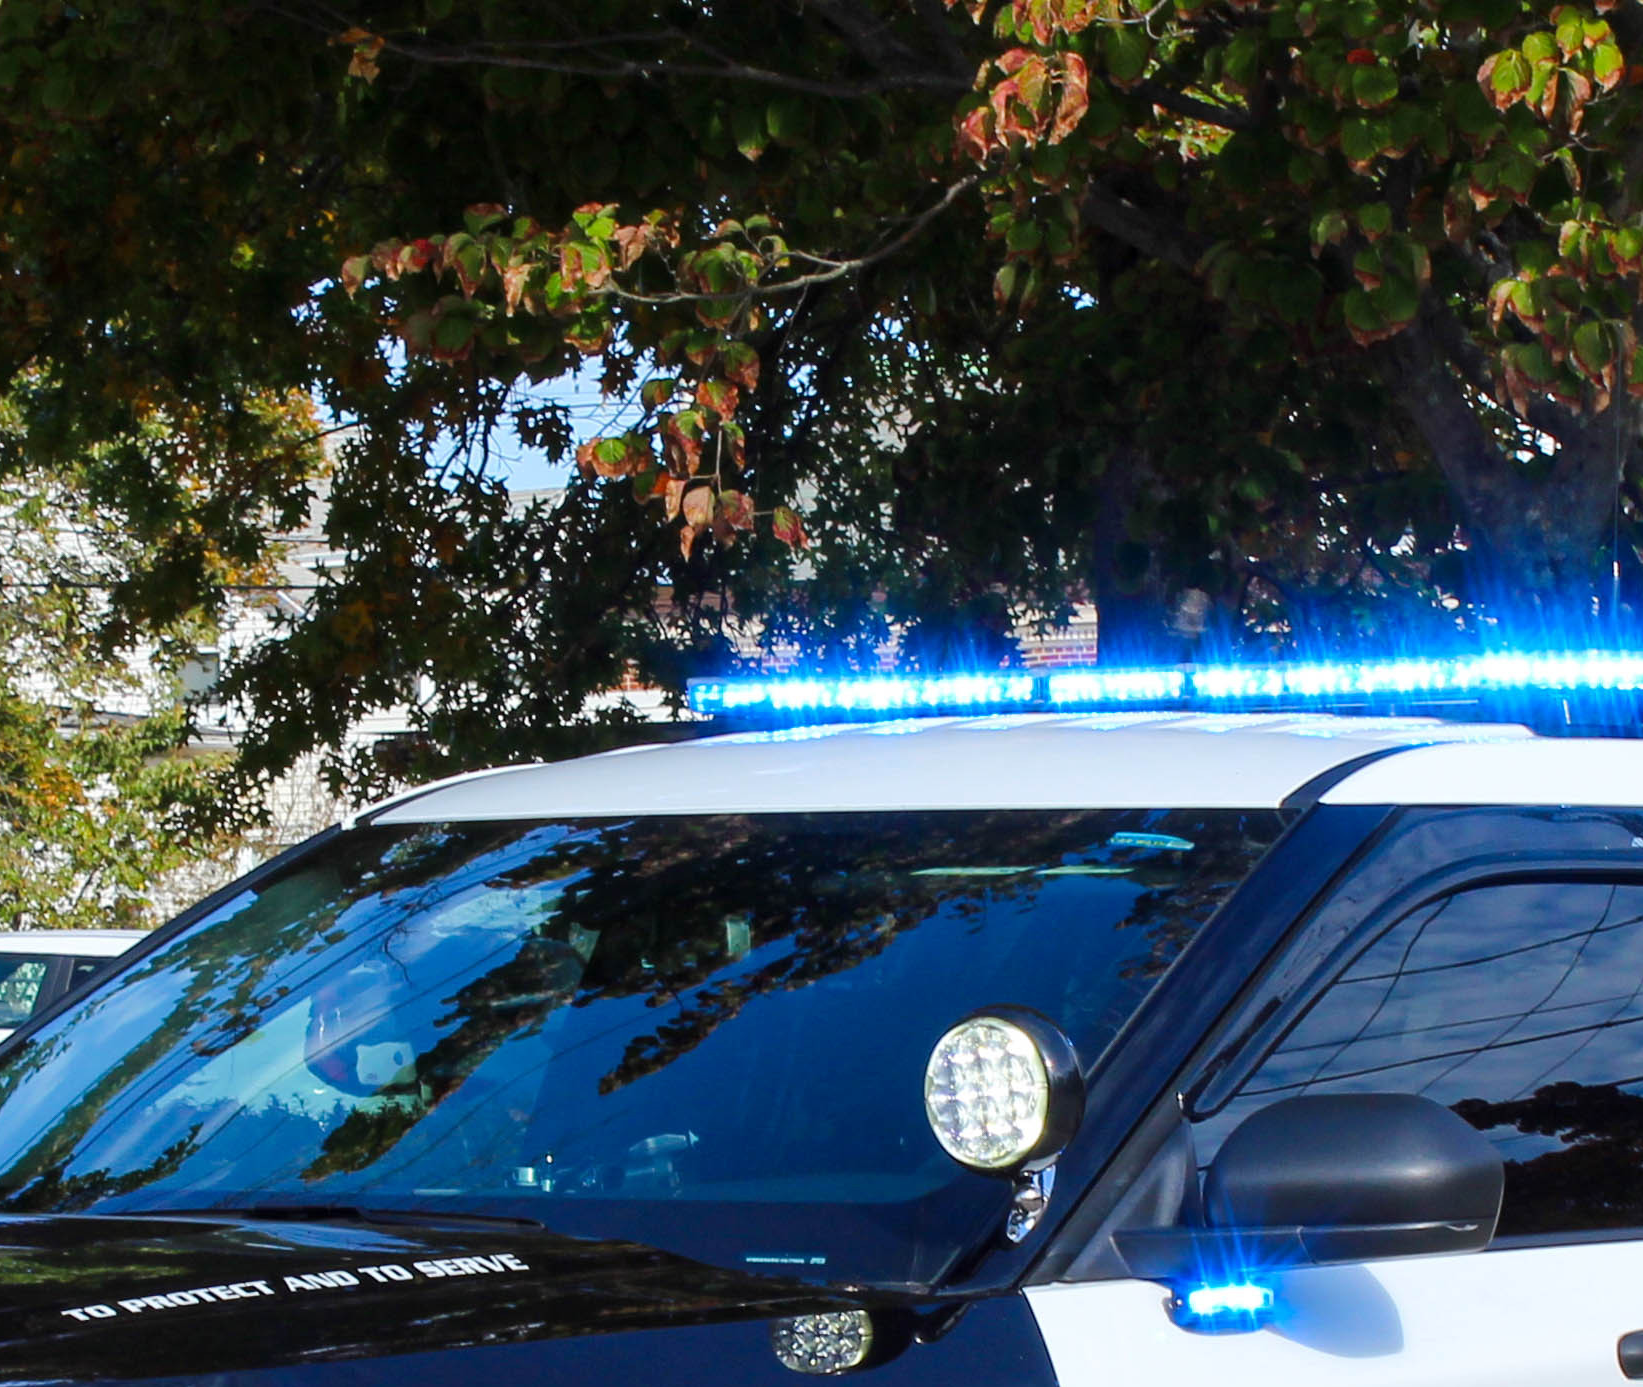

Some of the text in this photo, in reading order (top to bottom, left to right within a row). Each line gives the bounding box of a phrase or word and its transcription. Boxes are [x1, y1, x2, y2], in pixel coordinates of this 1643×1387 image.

[60, 1253, 530, 1321] TO PROTECT AND TO SERVE
